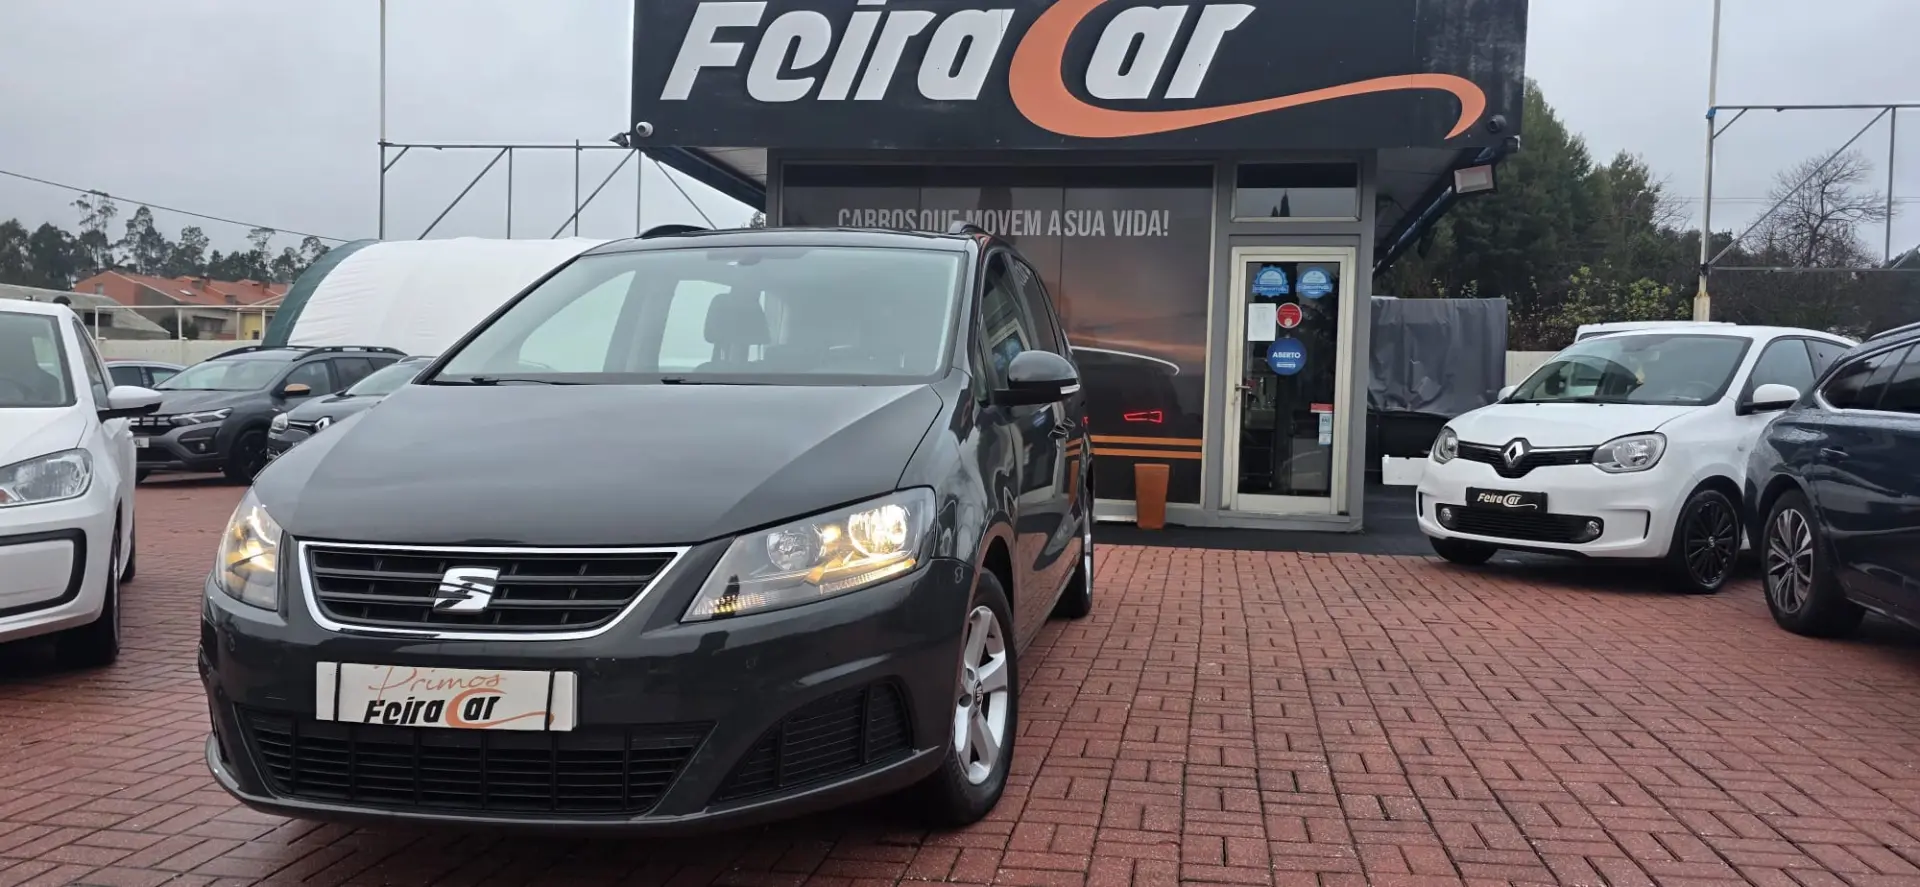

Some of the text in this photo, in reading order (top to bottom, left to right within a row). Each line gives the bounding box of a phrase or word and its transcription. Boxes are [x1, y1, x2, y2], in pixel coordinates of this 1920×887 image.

[965, 209, 1042, 237] MOVEM
[1112, 210, 1170, 237] VIDA!
[1272, 351, 1301, 359] ABERTO
[368, 665, 507, 706] Primos
